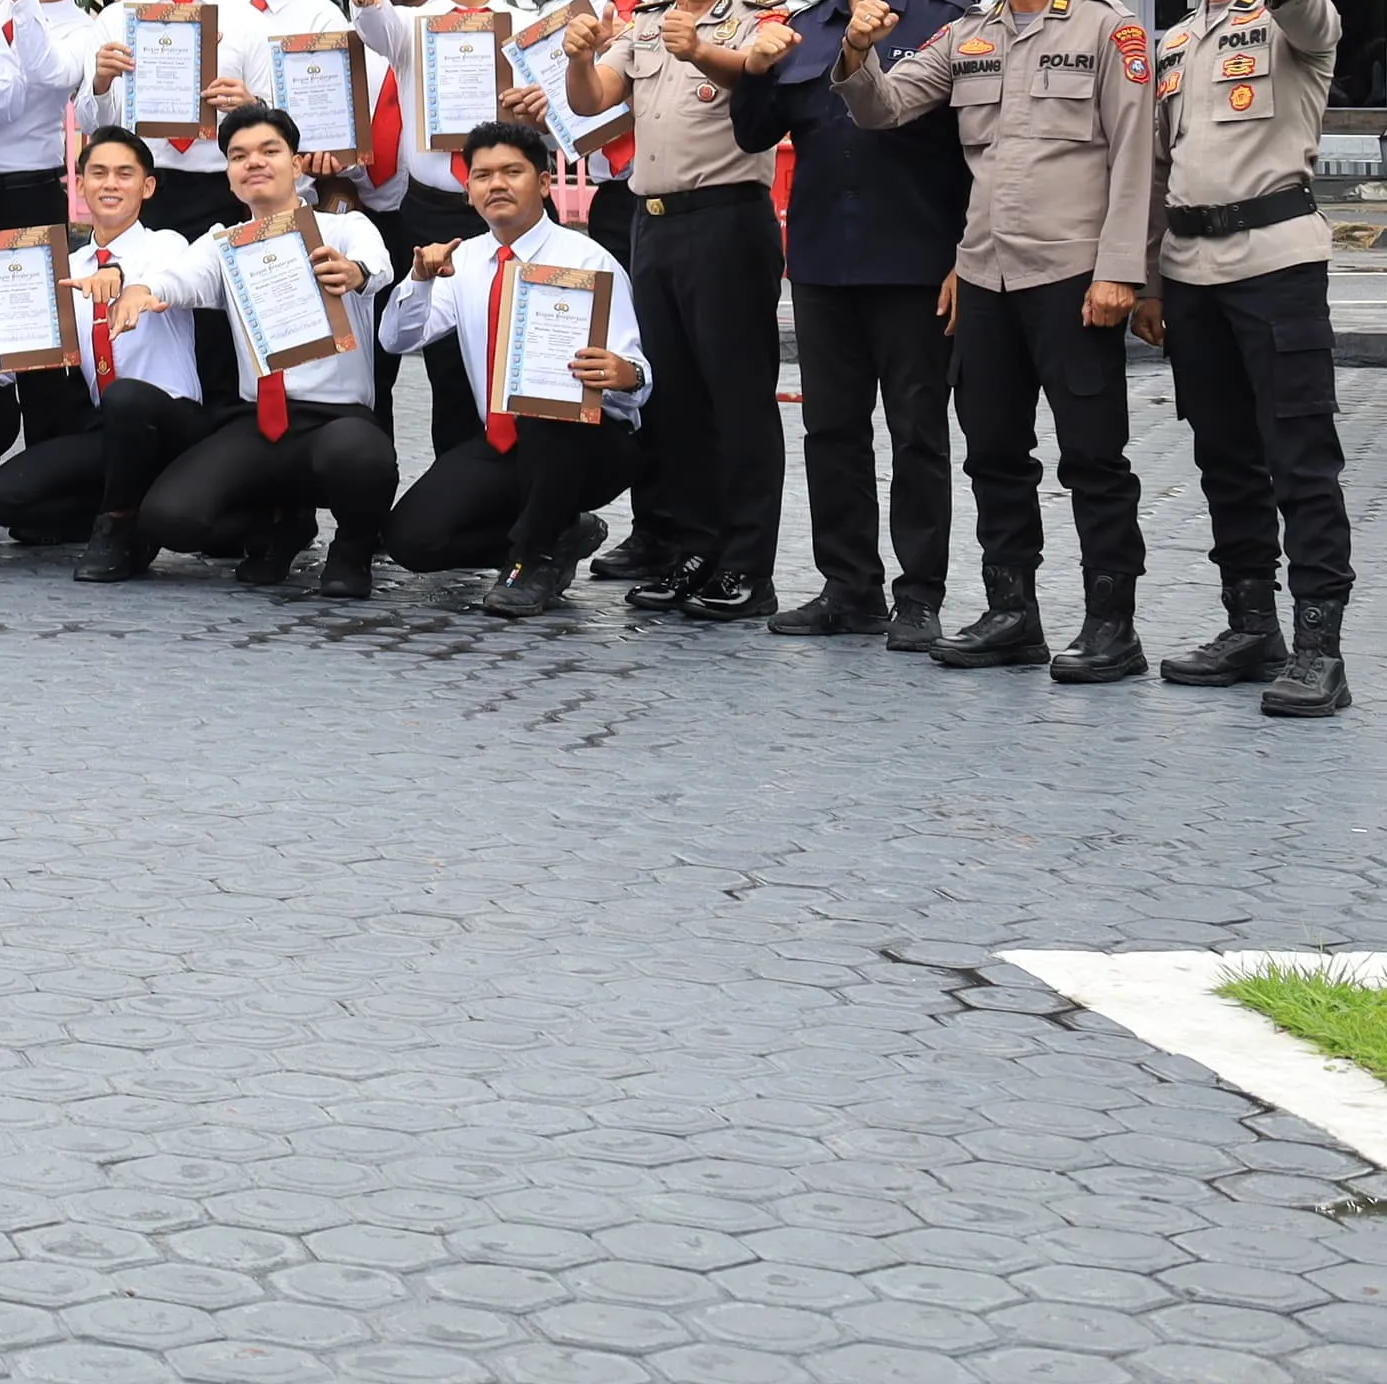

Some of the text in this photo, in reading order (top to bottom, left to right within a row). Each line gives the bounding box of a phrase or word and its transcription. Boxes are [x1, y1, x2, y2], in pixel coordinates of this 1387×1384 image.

[1218, 26, 1268, 50] POLRI
[951, 58, 1002, 77] BAMBANG
[1038, 53, 1095, 69] POLRI
